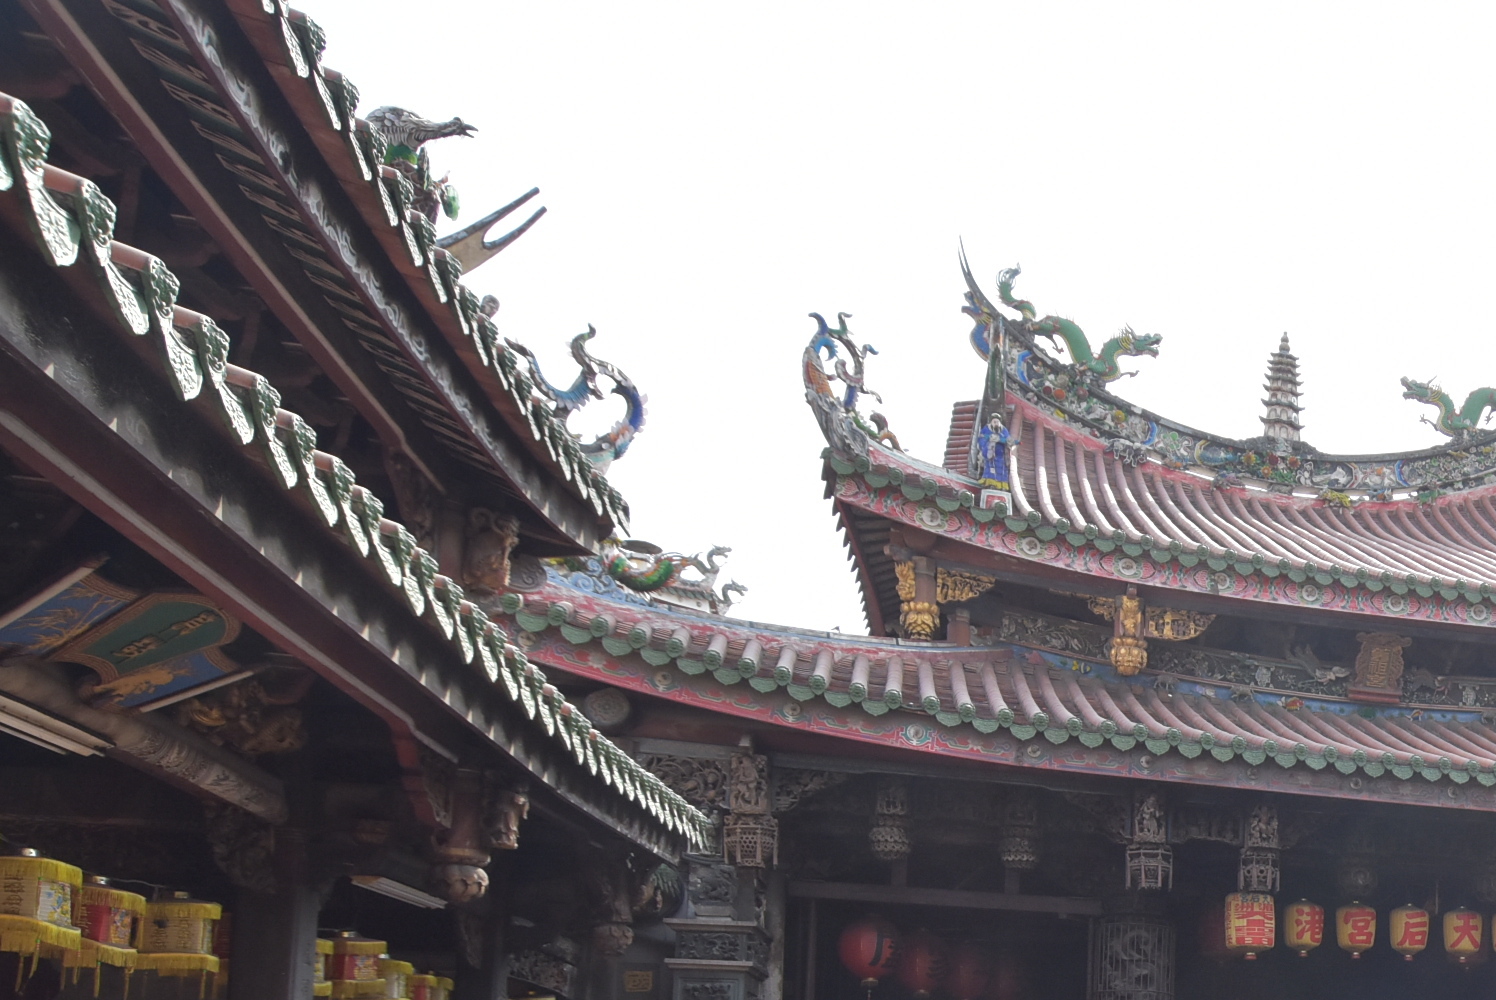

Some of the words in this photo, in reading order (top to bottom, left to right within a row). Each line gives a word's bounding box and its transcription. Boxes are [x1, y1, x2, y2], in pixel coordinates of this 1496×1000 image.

[1295, 906, 1324, 944] 港
[1343, 908, 1377, 945] 宮
[1397, 911, 1428, 947] 后
[1450, 913, 1479, 949] 天
